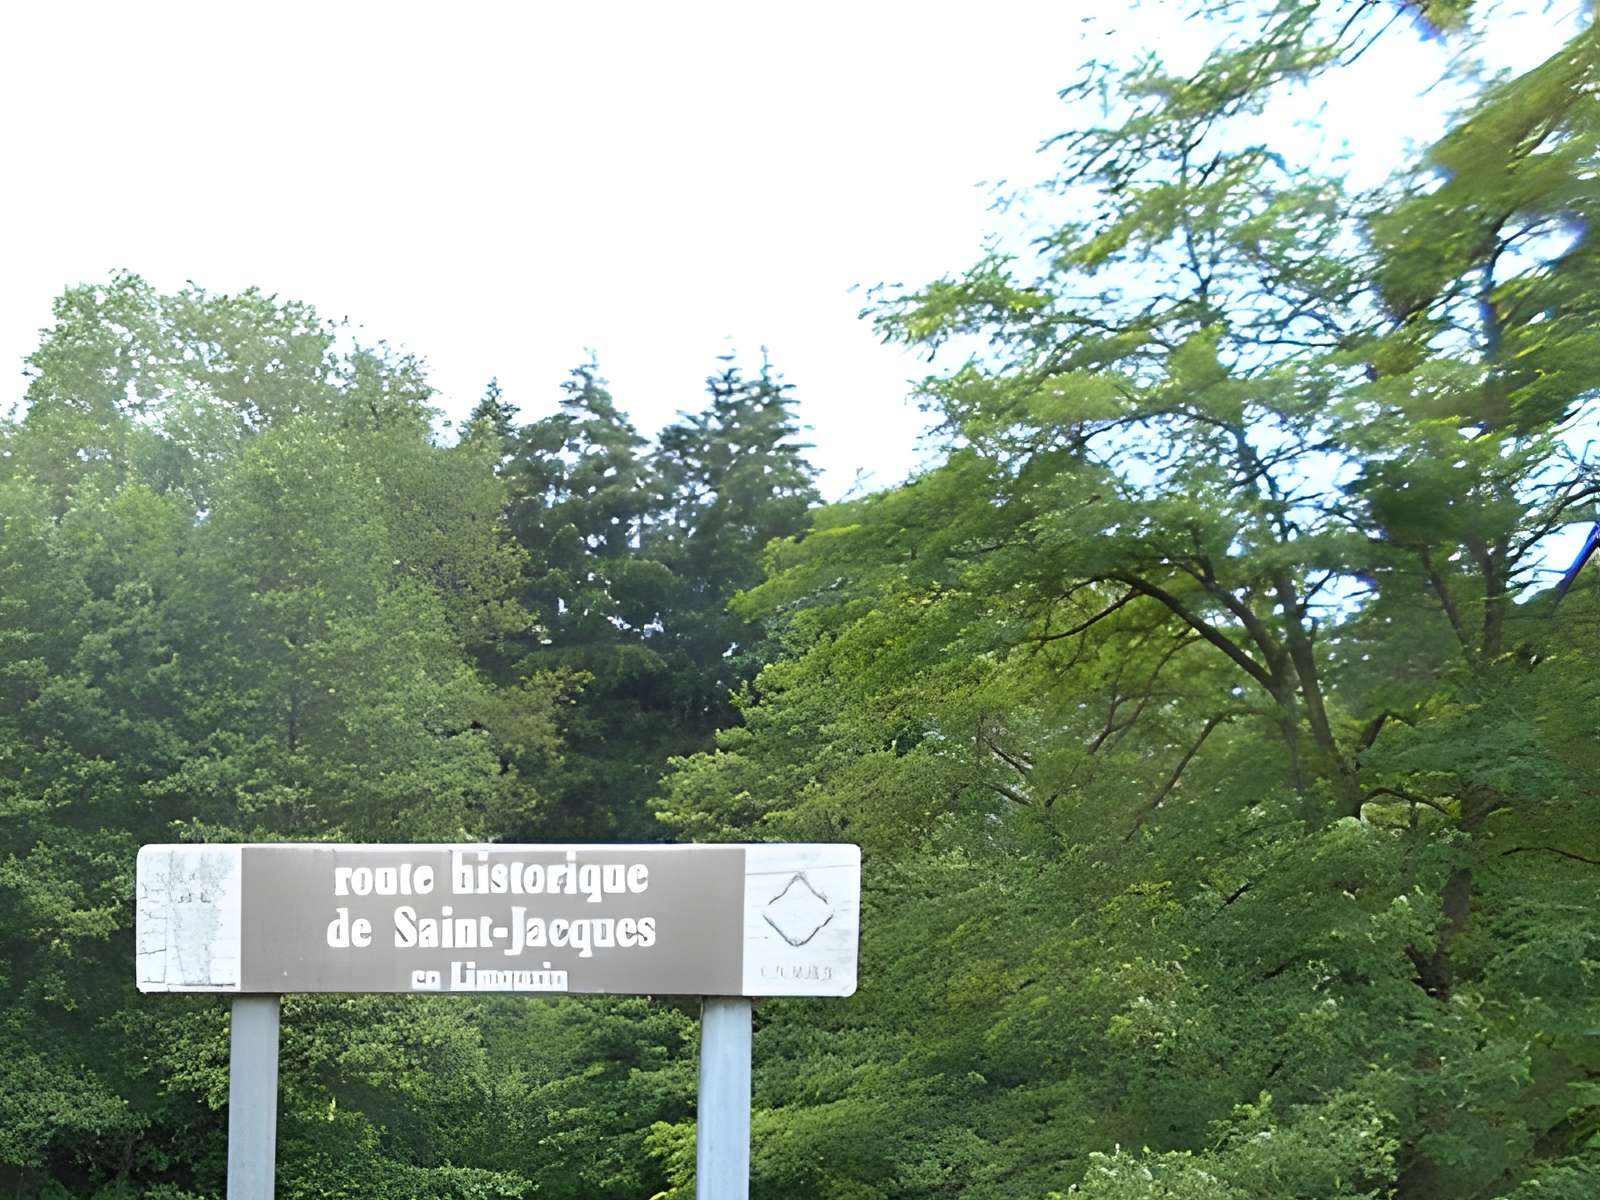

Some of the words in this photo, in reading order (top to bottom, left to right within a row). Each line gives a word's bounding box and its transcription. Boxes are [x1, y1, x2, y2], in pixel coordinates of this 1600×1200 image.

[334, 864, 434, 895] route
[451, 850, 649, 903] historique
[326, 908, 372, 948] de
[394, 906, 656, 957] Saint-Jacques
